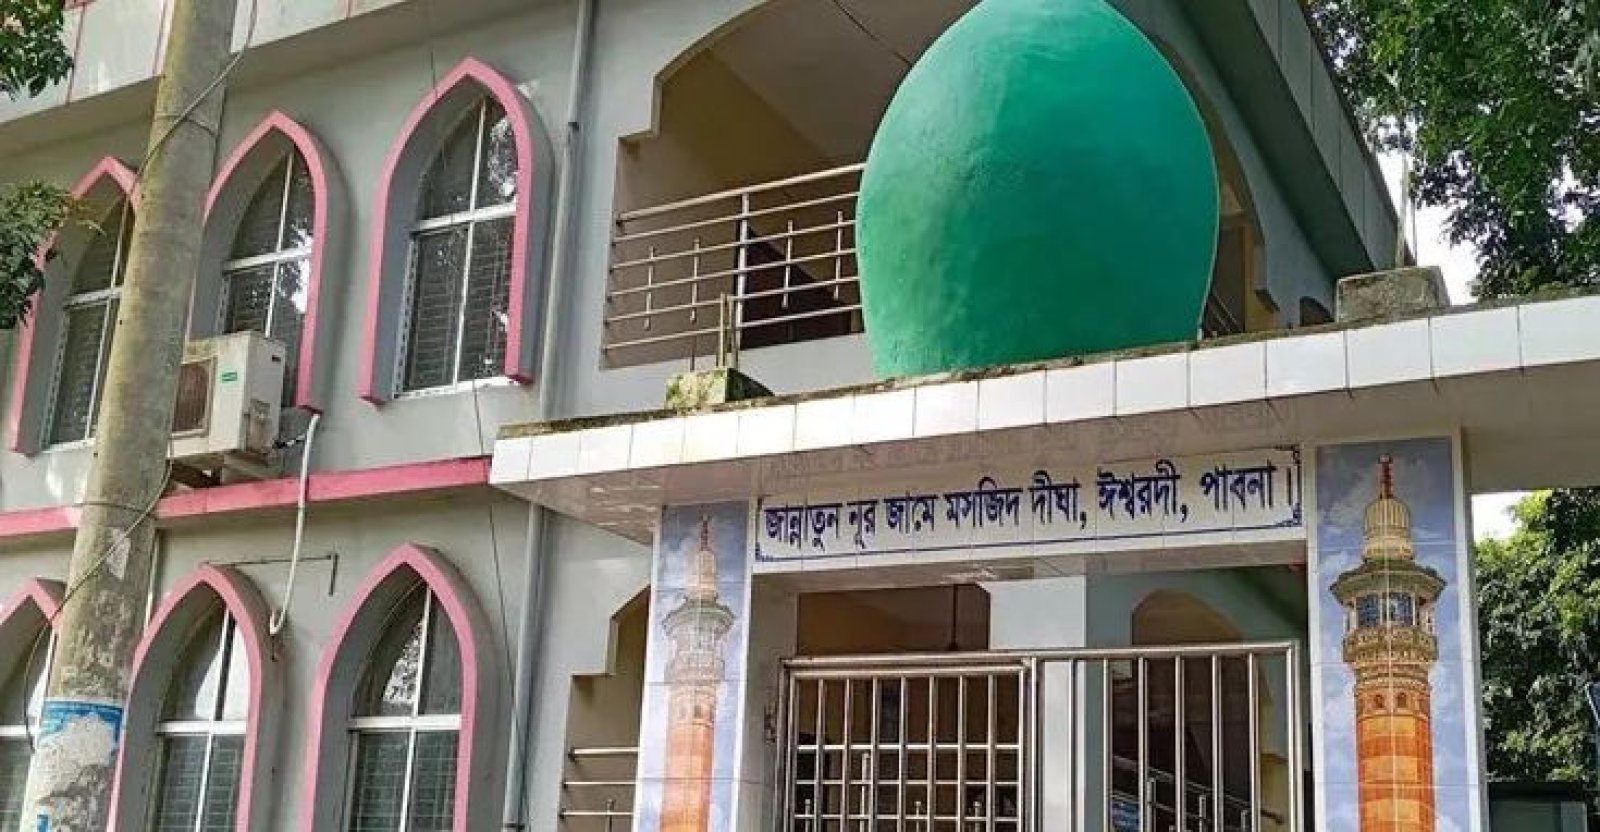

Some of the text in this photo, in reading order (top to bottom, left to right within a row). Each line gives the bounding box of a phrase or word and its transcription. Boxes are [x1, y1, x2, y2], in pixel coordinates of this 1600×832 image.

[884, 491, 938, 533] জামে
[944, 476, 1023, 527] মসজিদ
[1096, 459, 1188, 523] ঈশ্বরদী,
